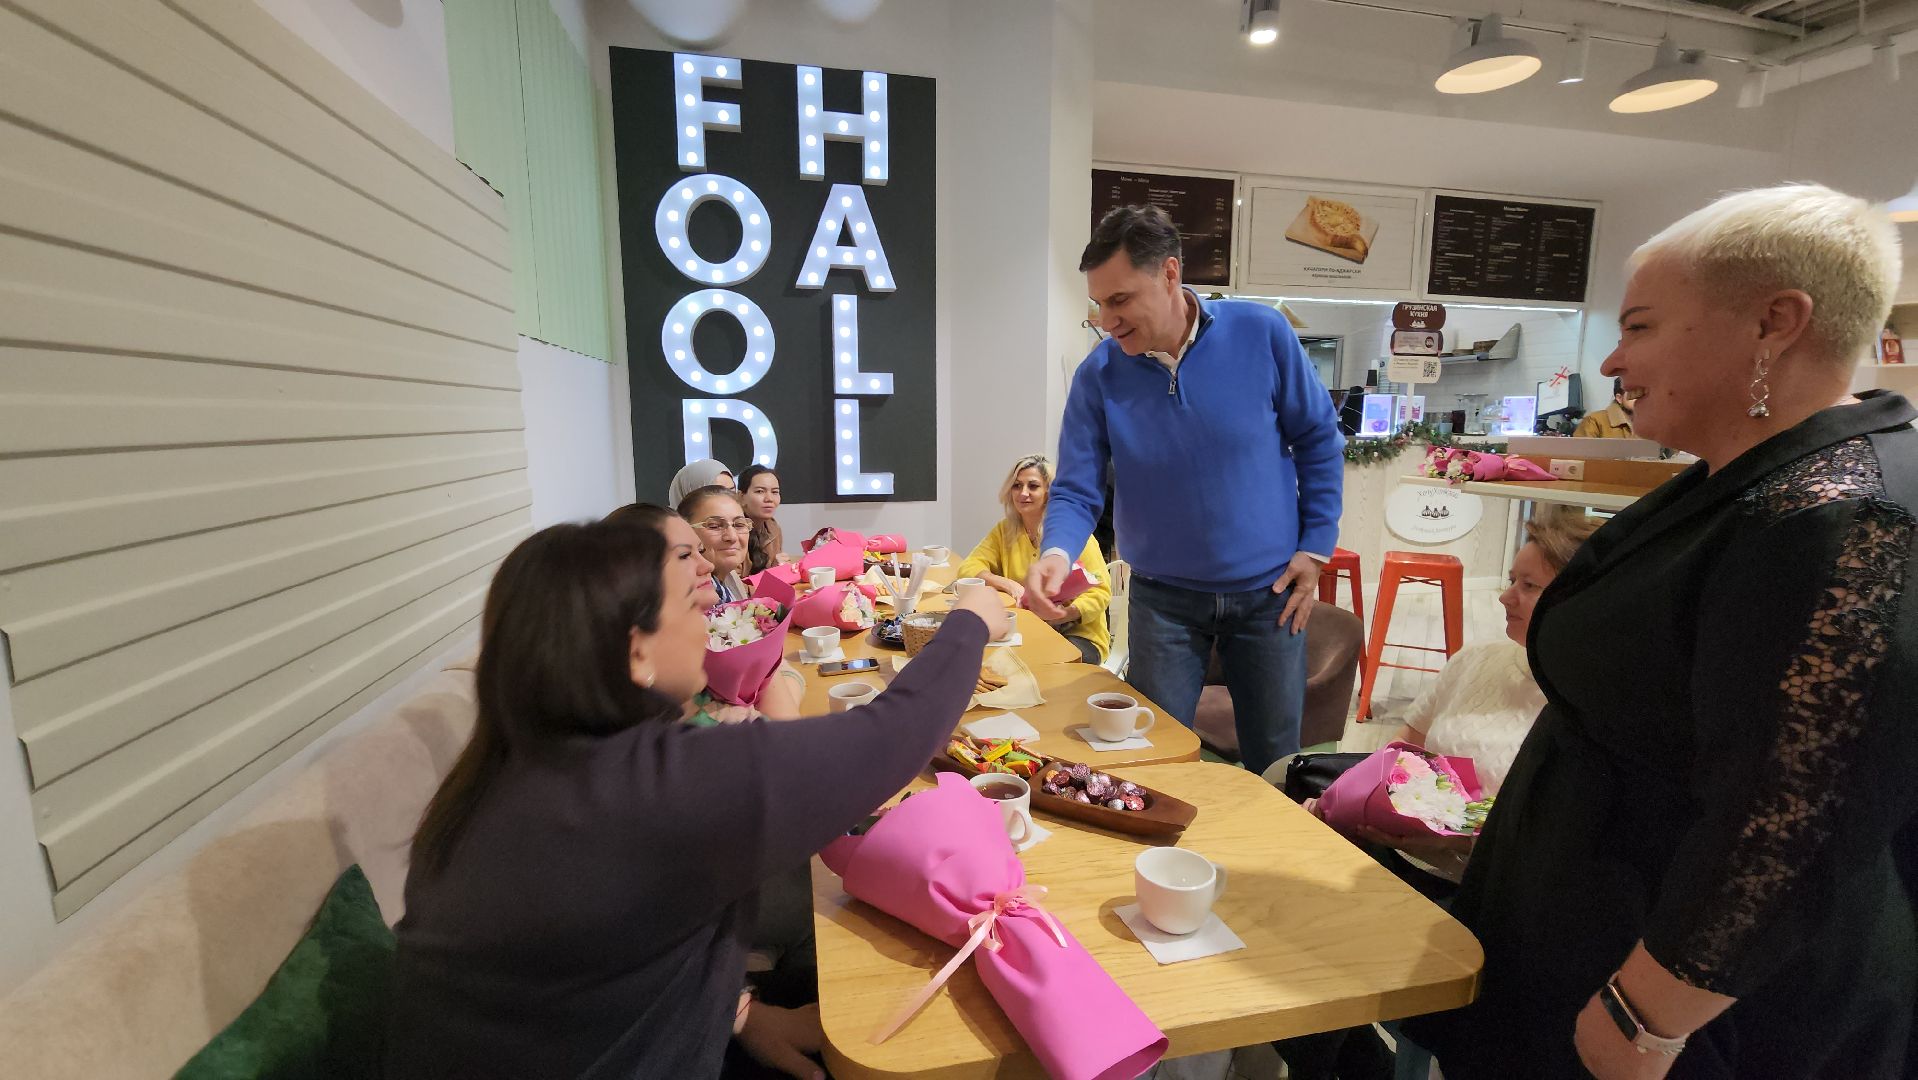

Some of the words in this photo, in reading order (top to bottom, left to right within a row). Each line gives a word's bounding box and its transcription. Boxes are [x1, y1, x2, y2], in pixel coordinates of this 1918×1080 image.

[655, 52, 779, 489] FOOD
[795, 64, 898, 496] HALL
[1402, 304, 1438, 312] ГРУЗИНСКАЯ
[1409, 310, 1429, 318] КУХНЯ
